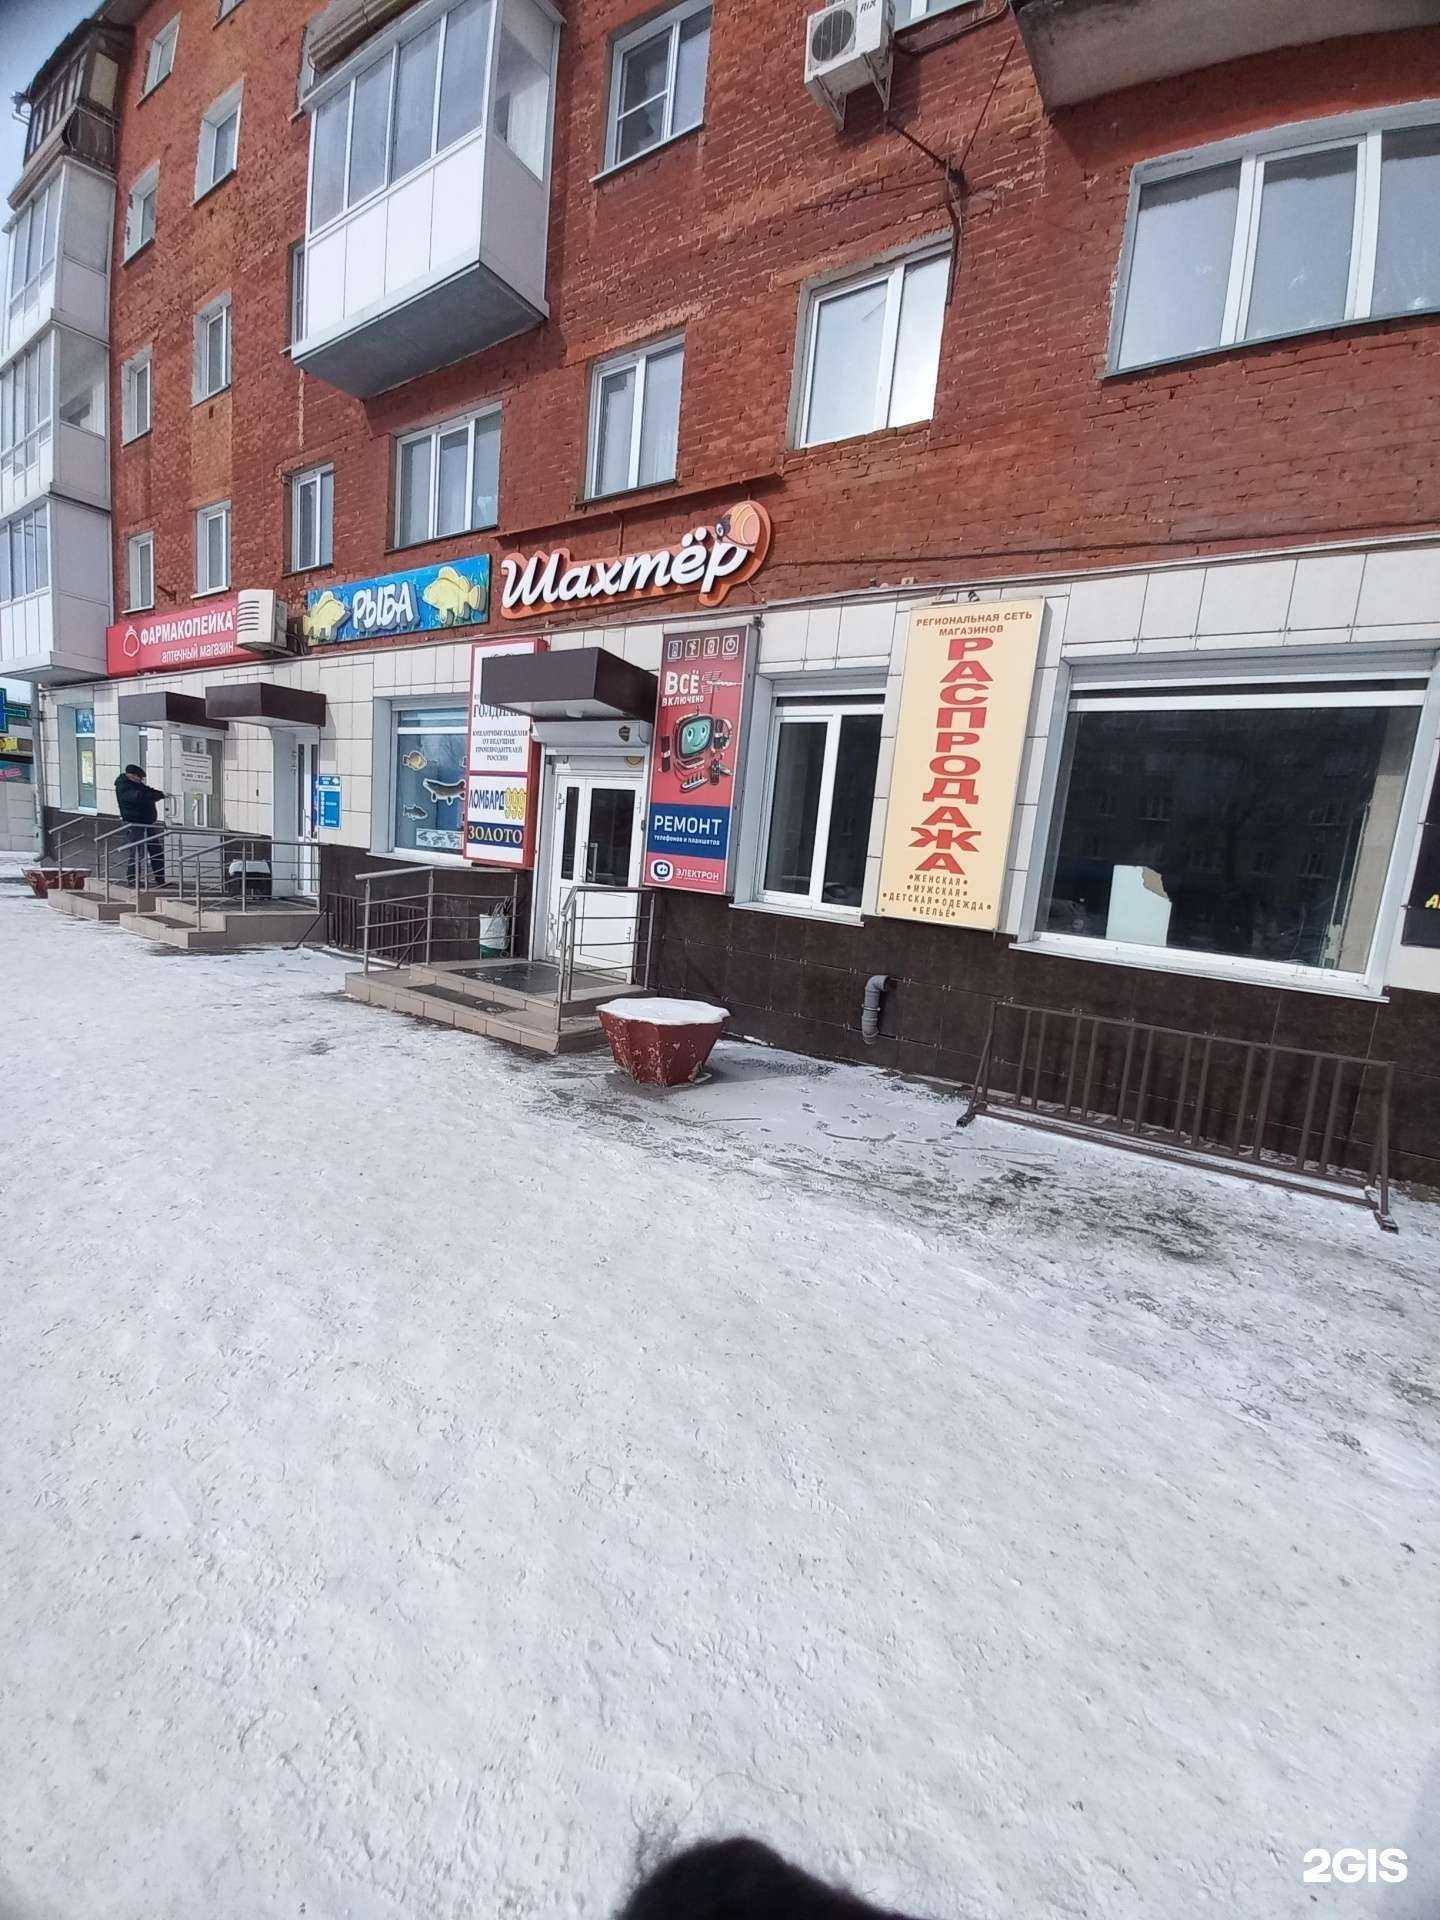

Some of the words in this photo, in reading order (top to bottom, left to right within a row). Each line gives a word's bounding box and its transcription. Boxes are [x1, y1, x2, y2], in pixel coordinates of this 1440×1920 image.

[501, 526, 750, 608] Шахтёр
[352, 582, 413, 629] РЫБА
[140, 609, 234, 646] ФАРМАКОПЕЙКА
[916, 613, 1000, 627] РЕГИОНАЛЬНАЯ
[1004, 611, 1032, 621] СЕТЬ
[939, 624, 1004, 637] МАГАЗИНОВ
[161, 643, 198, 663] аптечный
[199, 640, 234, 657] магазин
[664, 669, 700, 695] ВСЁ
[661, 695, 704, 707] ВКЛЮЧЕНО
[908, 637, 994, 876] РАСПРОДАЖА
[654, 815, 723, 835] РЕМОНТ
[468, 825, 523, 845] ЗОЛОТО
[654, 834, 683, 843] телефонов
[688, 837, 720, 846] планшетов
[676, 867, 719, 881] ЭЛЕКТРОН
[914, 874, 961, 886] ЖЕНСКАЯ
[913, 884, 961, 897] МУЖСКАЯ
[889, 892, 933, 905] ДЕТСКАЯ
[942, 898, 984, 911] ОДЕЖДА
